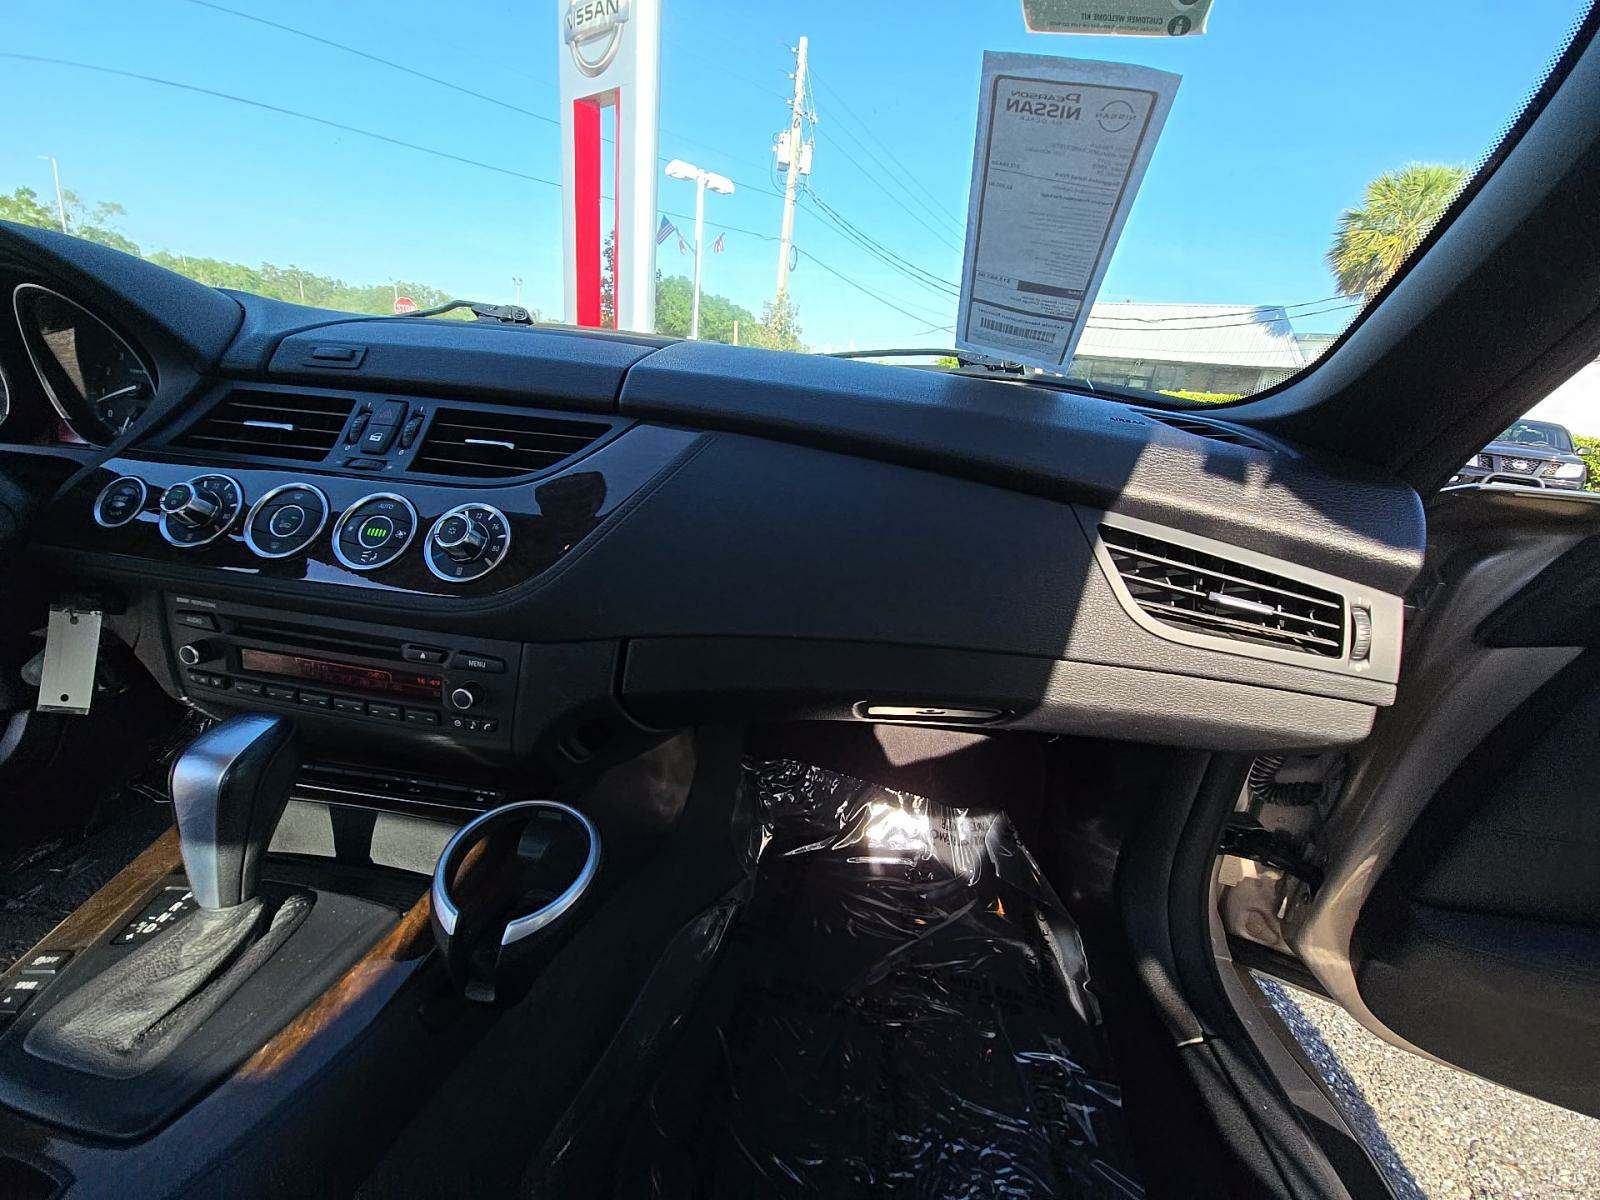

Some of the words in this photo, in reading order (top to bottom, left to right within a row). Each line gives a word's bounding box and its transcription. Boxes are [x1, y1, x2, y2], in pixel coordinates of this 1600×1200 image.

[567, 0, 619, 30] NISSAN
[396, 304, 416, 314] STOP
[468, 659, 486, 669] MENU
